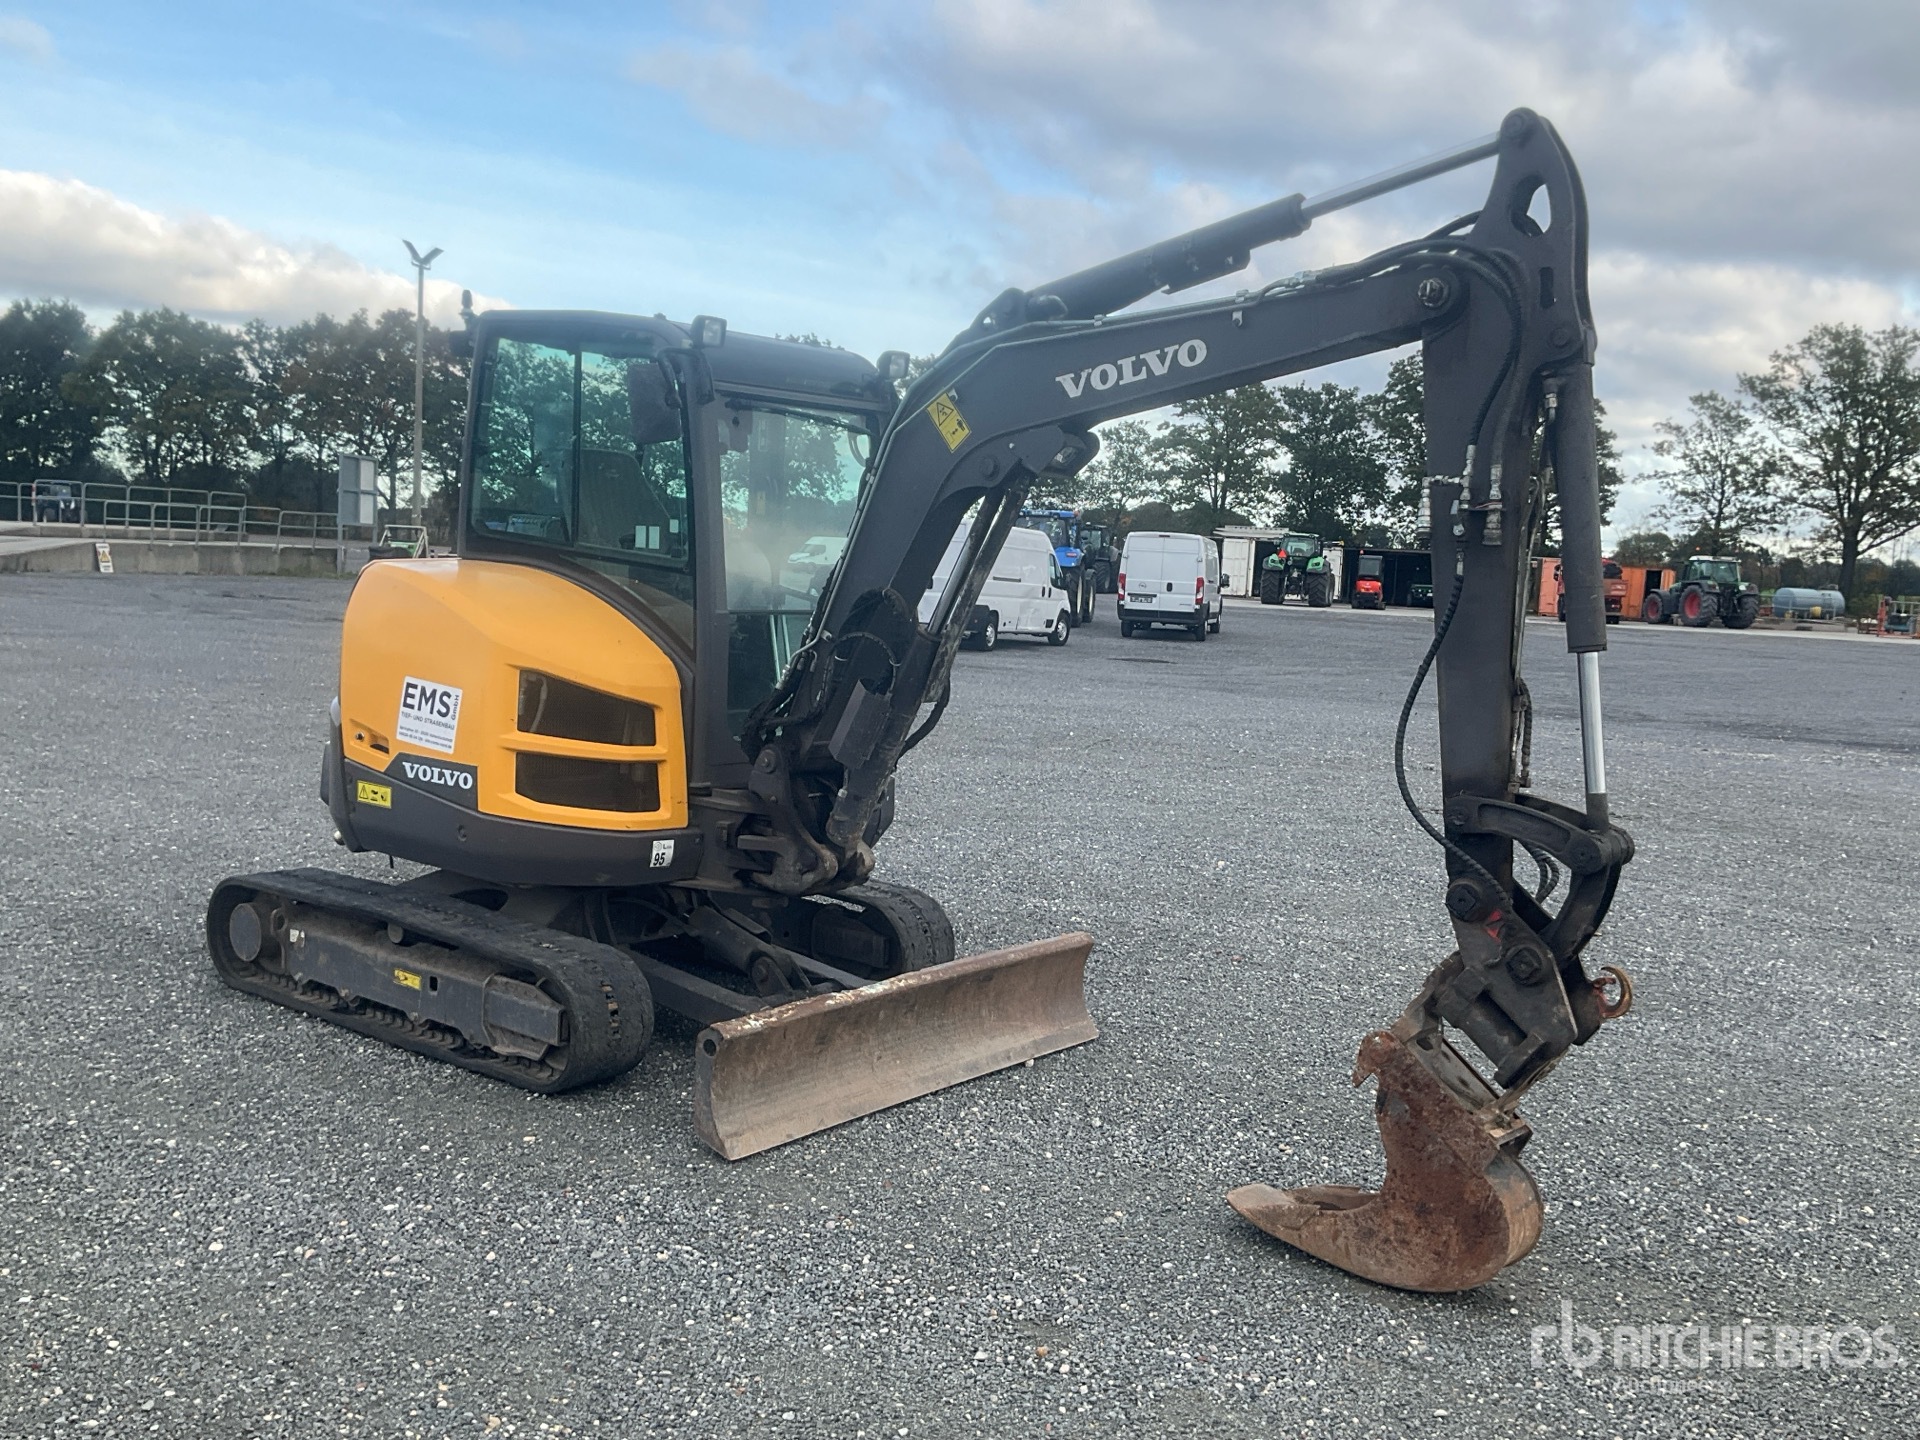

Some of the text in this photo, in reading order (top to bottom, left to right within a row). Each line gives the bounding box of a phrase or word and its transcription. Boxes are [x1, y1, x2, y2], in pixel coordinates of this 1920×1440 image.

[1055, 339, 1208, 399] VOLVO
[402, 681, 452, 718] EMS
[450, 694, 460, 721] GmbH
[413, 714, 424, 722] UND
[402, 761, 473, 789] VOLVO
[653, 852, 666, 866] 95
